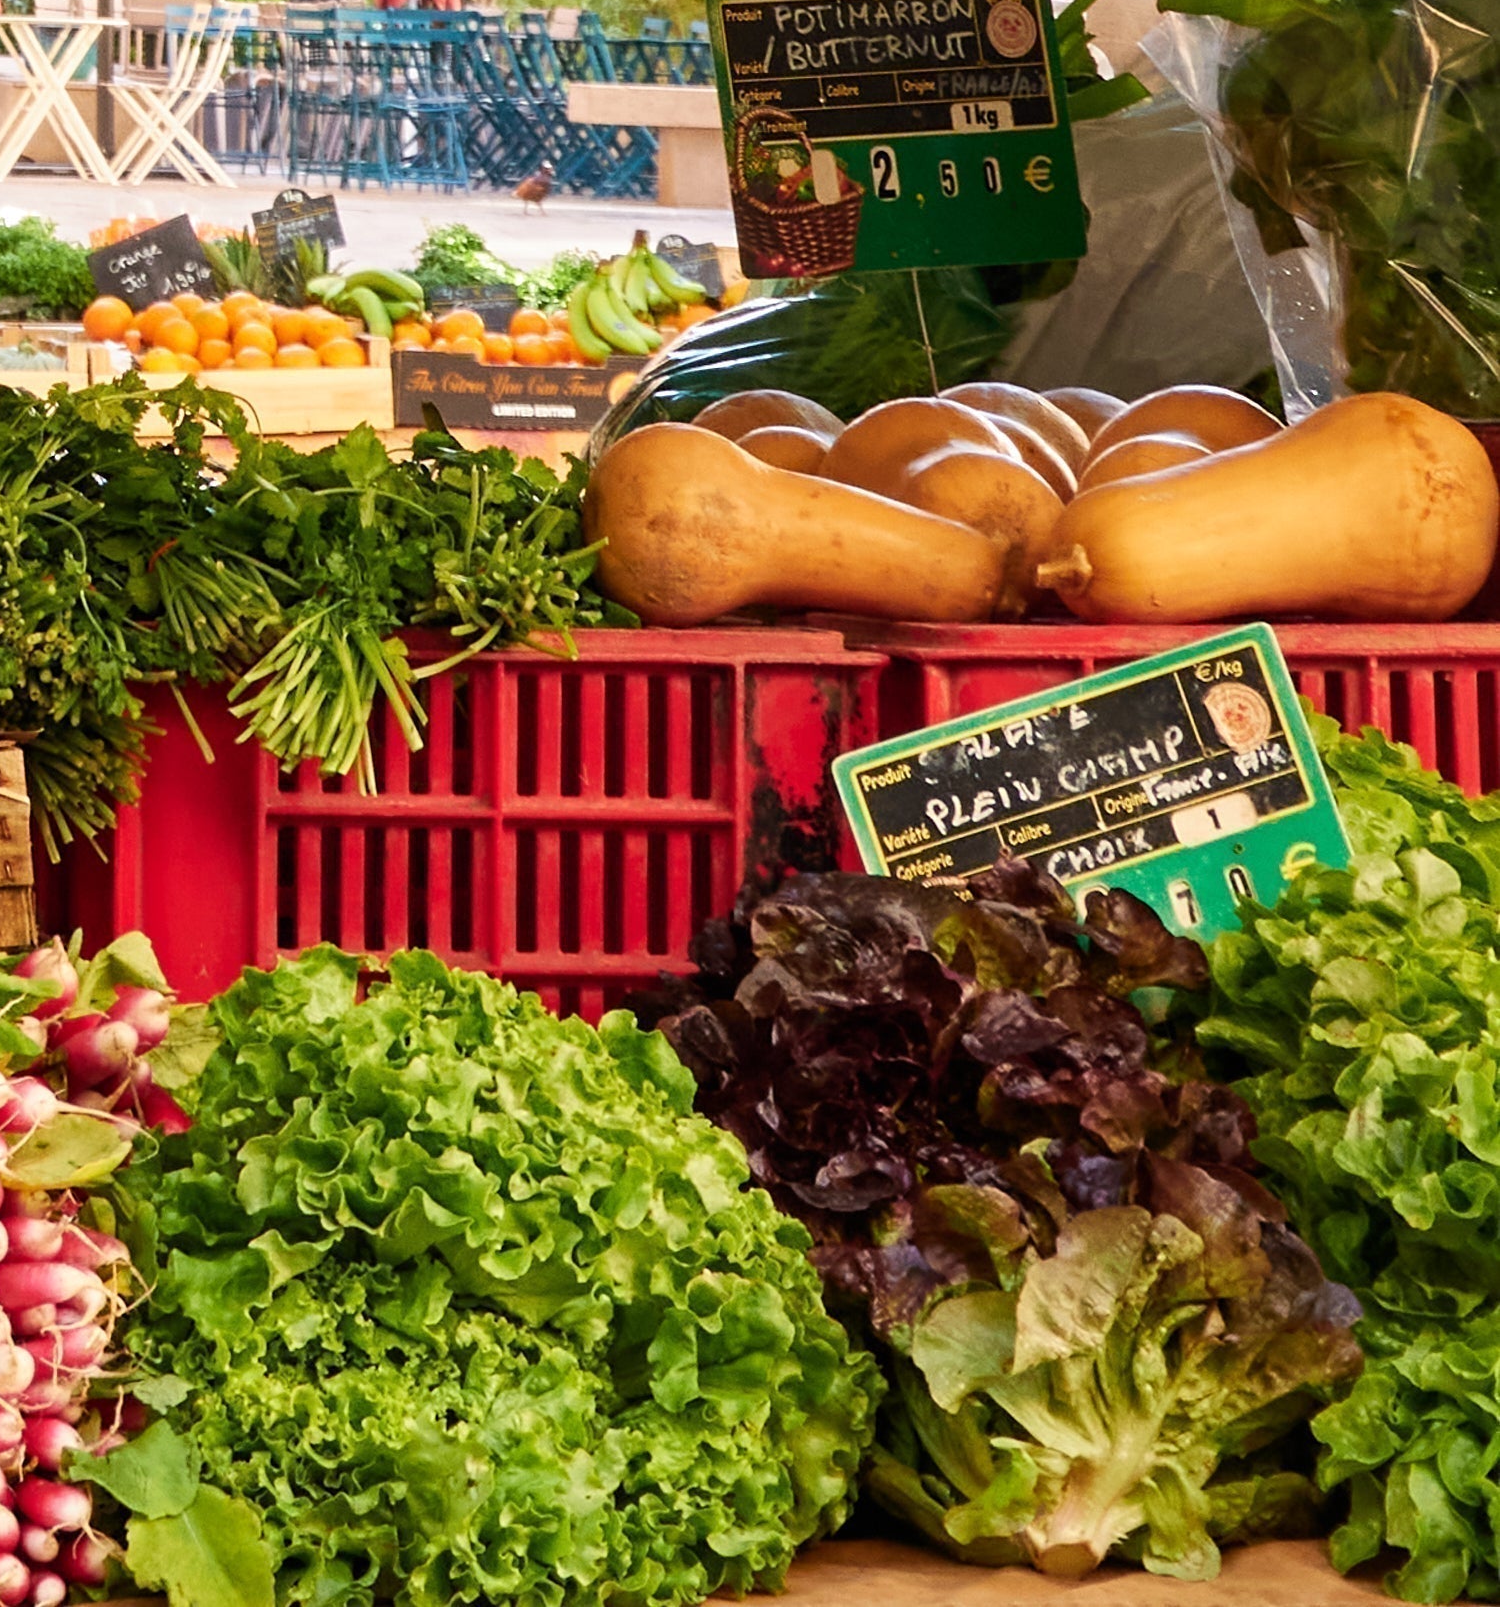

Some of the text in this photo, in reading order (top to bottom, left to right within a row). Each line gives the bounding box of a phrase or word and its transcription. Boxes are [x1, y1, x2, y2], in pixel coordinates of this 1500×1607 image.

[725, 9, 763, 22] Produit
[786, 30, 975, 72] BUTTERNUT
[826, 83, 860, 98] Calibre
[902, 78, 936, 93] Origine
[1195, 658, 1243, 683] €/kg
[860, 763, 912, 792] Produit
[883, 822, 931, 853] Variété
[896, 852, 955, 882] Catégorie
[1008, 821, 1053, 847] Calibre
[1048, 827, 1153, 883] CHOIX
